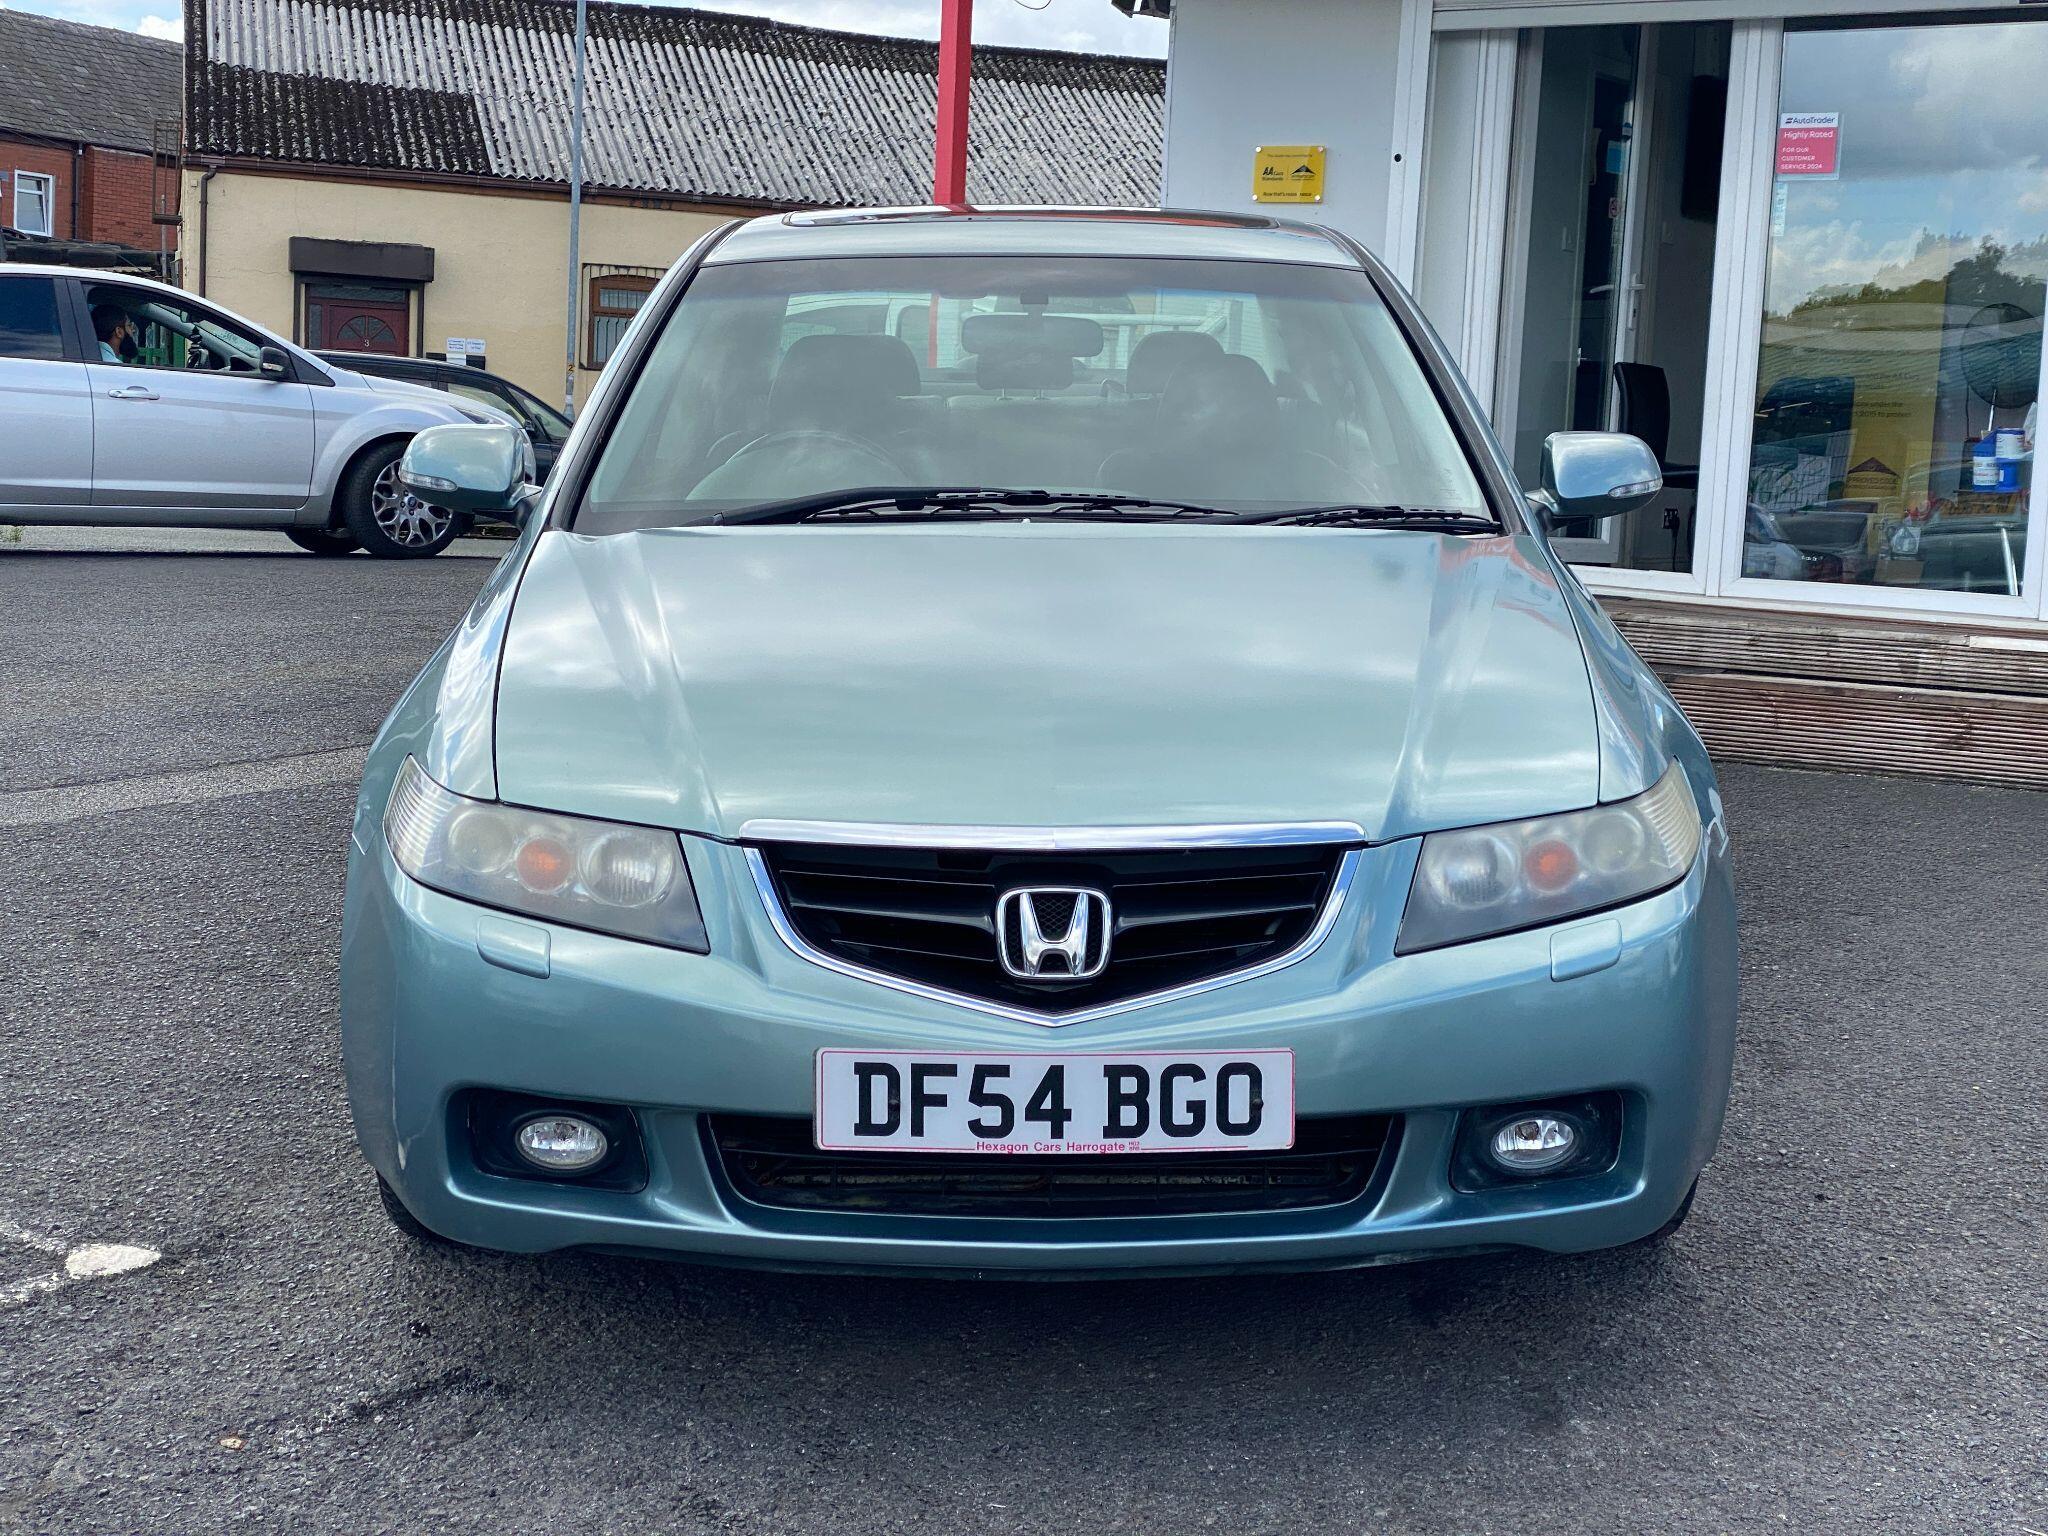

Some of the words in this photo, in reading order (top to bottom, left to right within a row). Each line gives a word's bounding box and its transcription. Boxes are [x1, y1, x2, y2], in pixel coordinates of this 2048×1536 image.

[1793, 116, 1835, 124] AutoTrader
[1784, 131, 1808, 140] Highly
[1809, 130, 1833, 138] Rated
[1262, 166, 1274, 176] AA
[364, 339, 370, 347] 3
[854, 1062, 1071, 1139] DF54
[1103, 1063, 1263, 1138] BGO
[976, 1141, 1028, 1153] Hexagon
[1033, 1142, 1061, 1151] Cars
[1066, 1142, 1125, 1153] Harrogate
